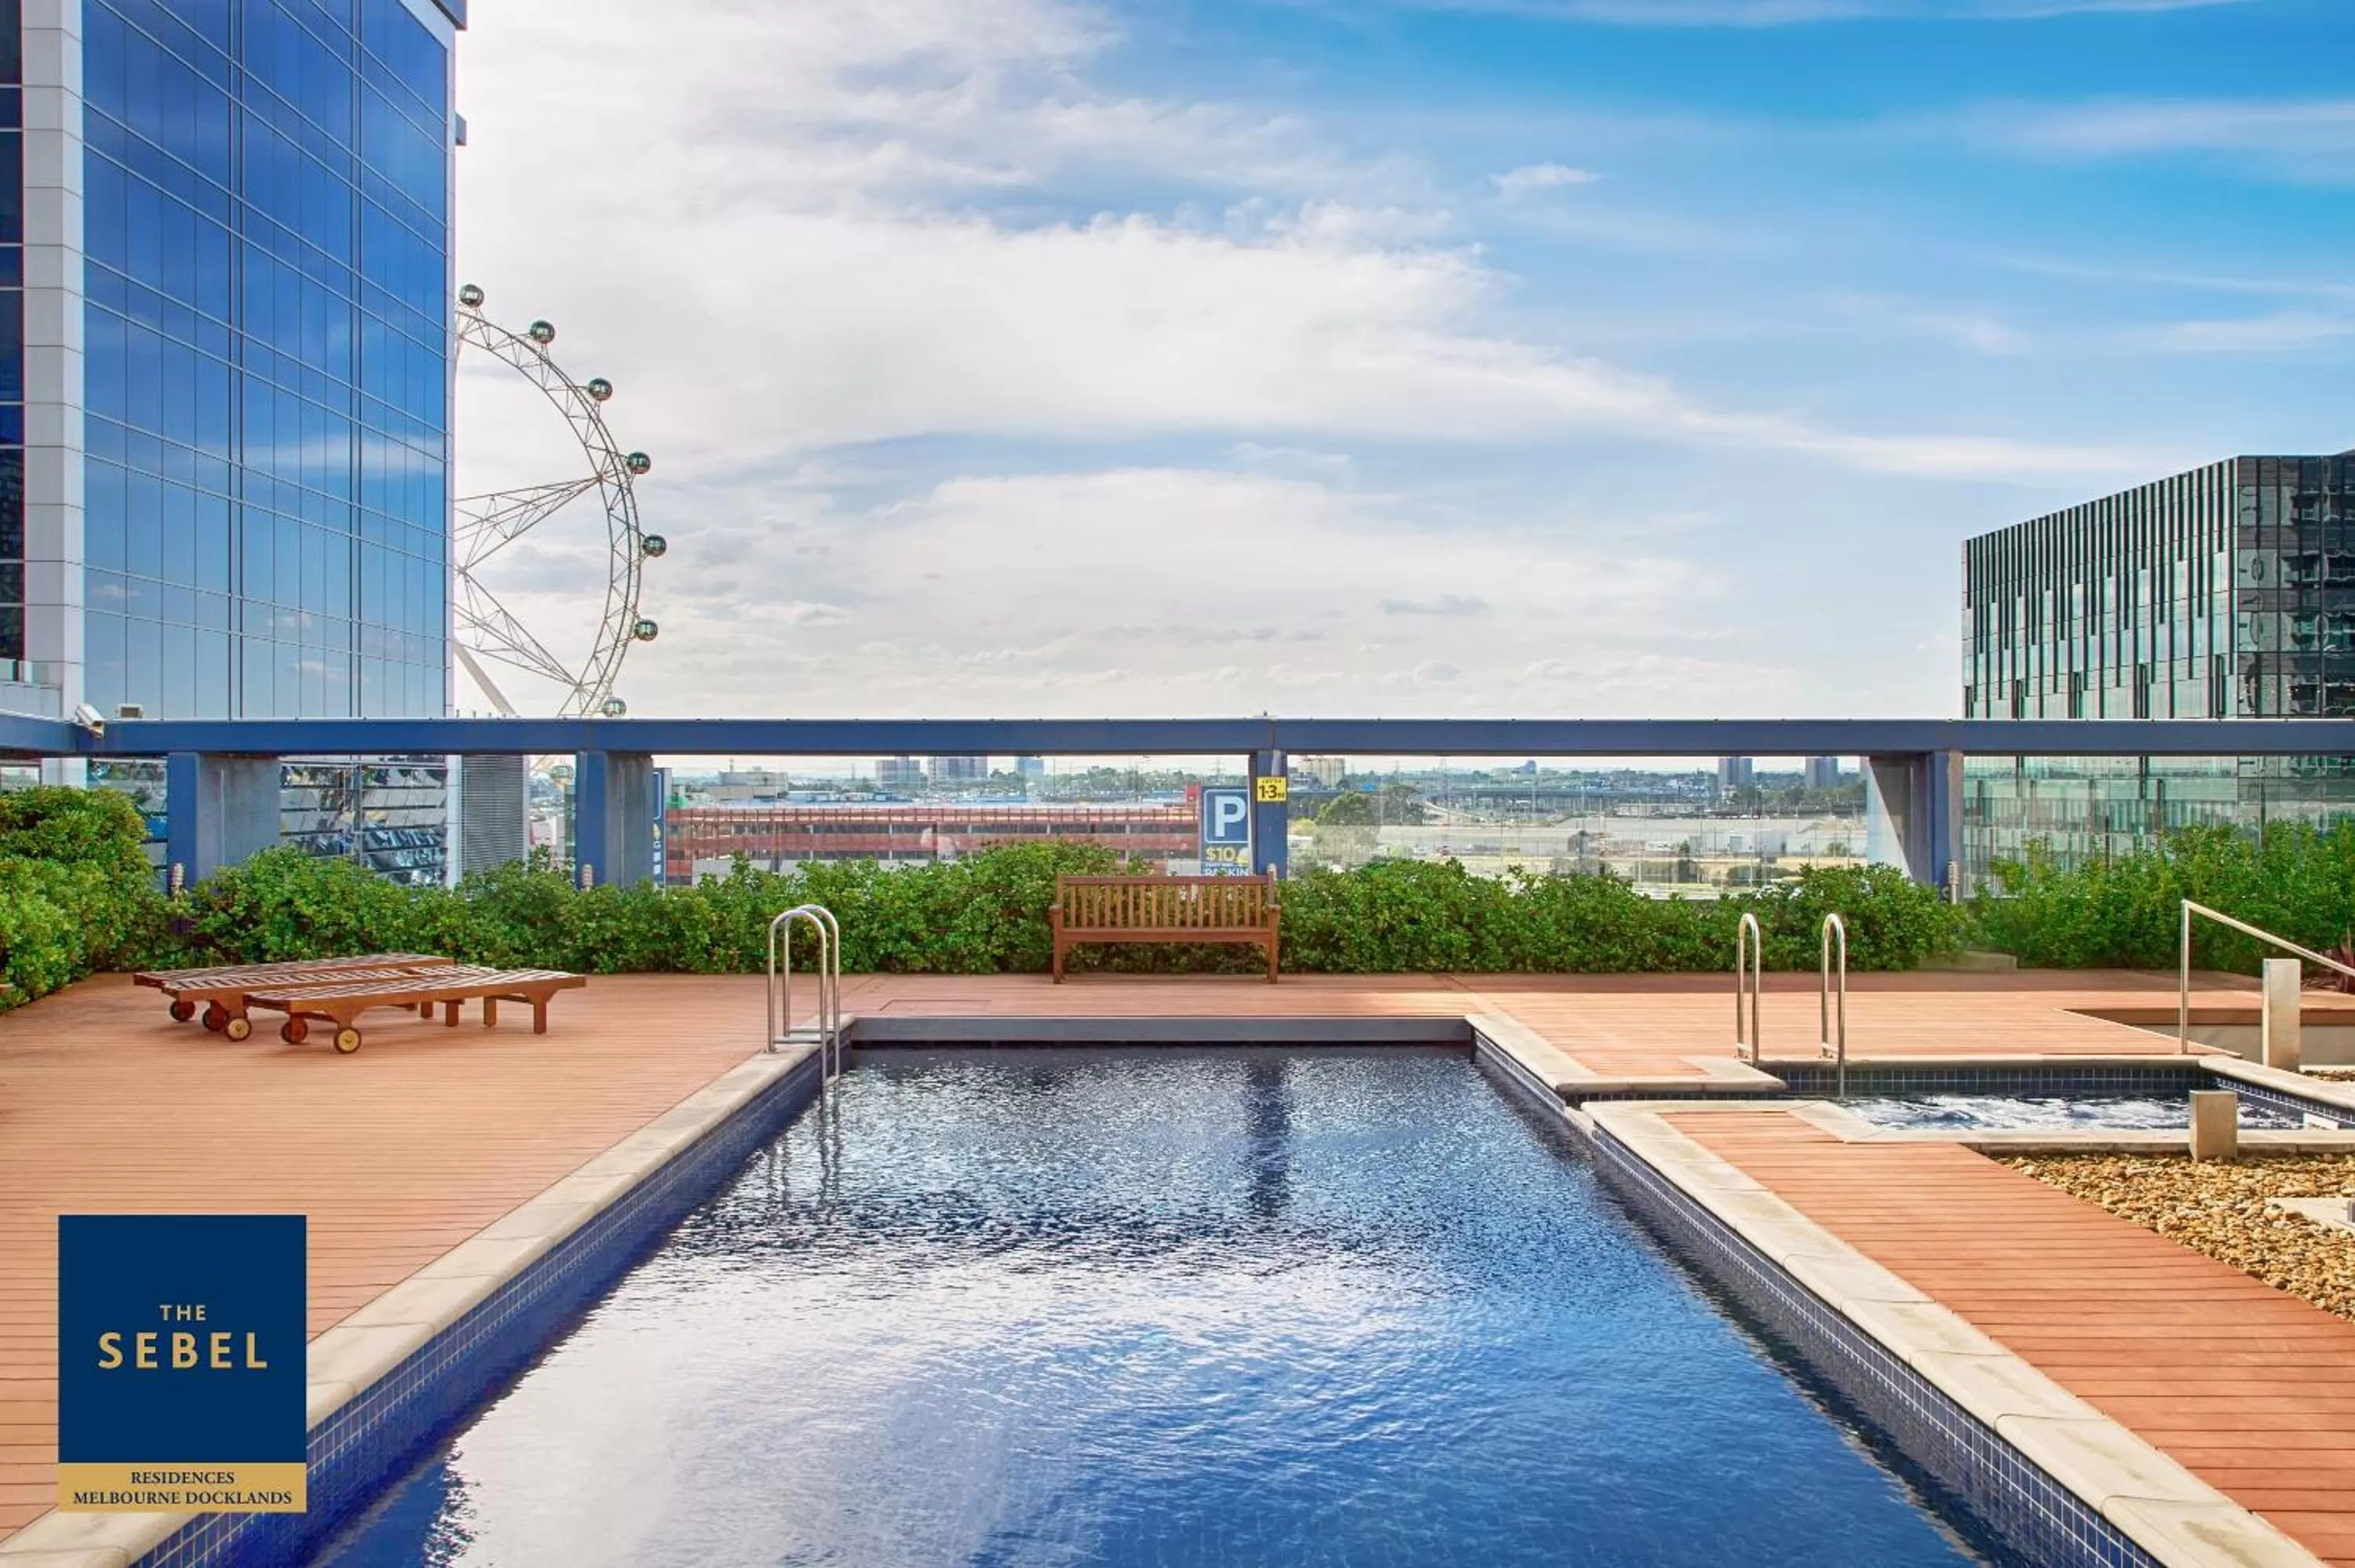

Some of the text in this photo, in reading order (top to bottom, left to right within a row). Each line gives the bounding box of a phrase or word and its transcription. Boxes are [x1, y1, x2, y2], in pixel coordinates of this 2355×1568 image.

[1214, 795, 1247, 837] P
[1206, 846, 1236, 862] $10
[1205, 867, 1250, 877] PKIN
